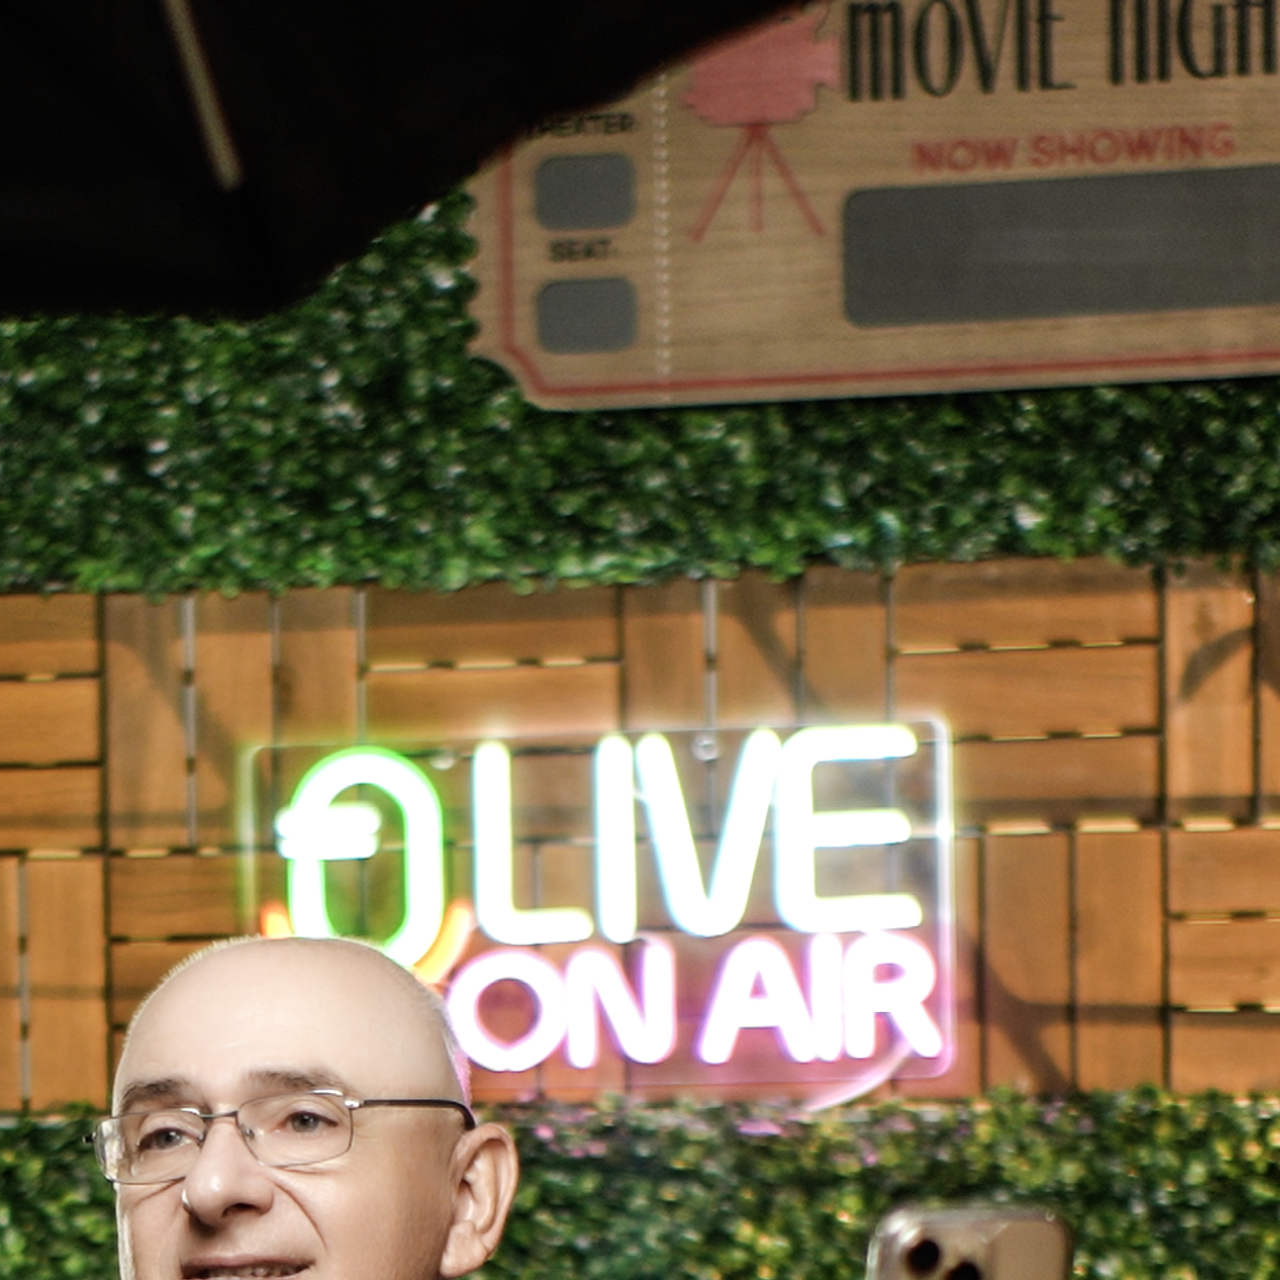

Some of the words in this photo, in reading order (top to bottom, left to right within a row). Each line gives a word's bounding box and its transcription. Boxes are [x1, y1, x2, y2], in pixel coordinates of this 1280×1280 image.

[911, 138, 1018, 172] NOW
[1029, 122, 1237, 168] SHOWING
[472, 724, 924, 946] LIVE
[446, 946, 677, 1073] ON
[695, 932, 943, 1066] AIR
